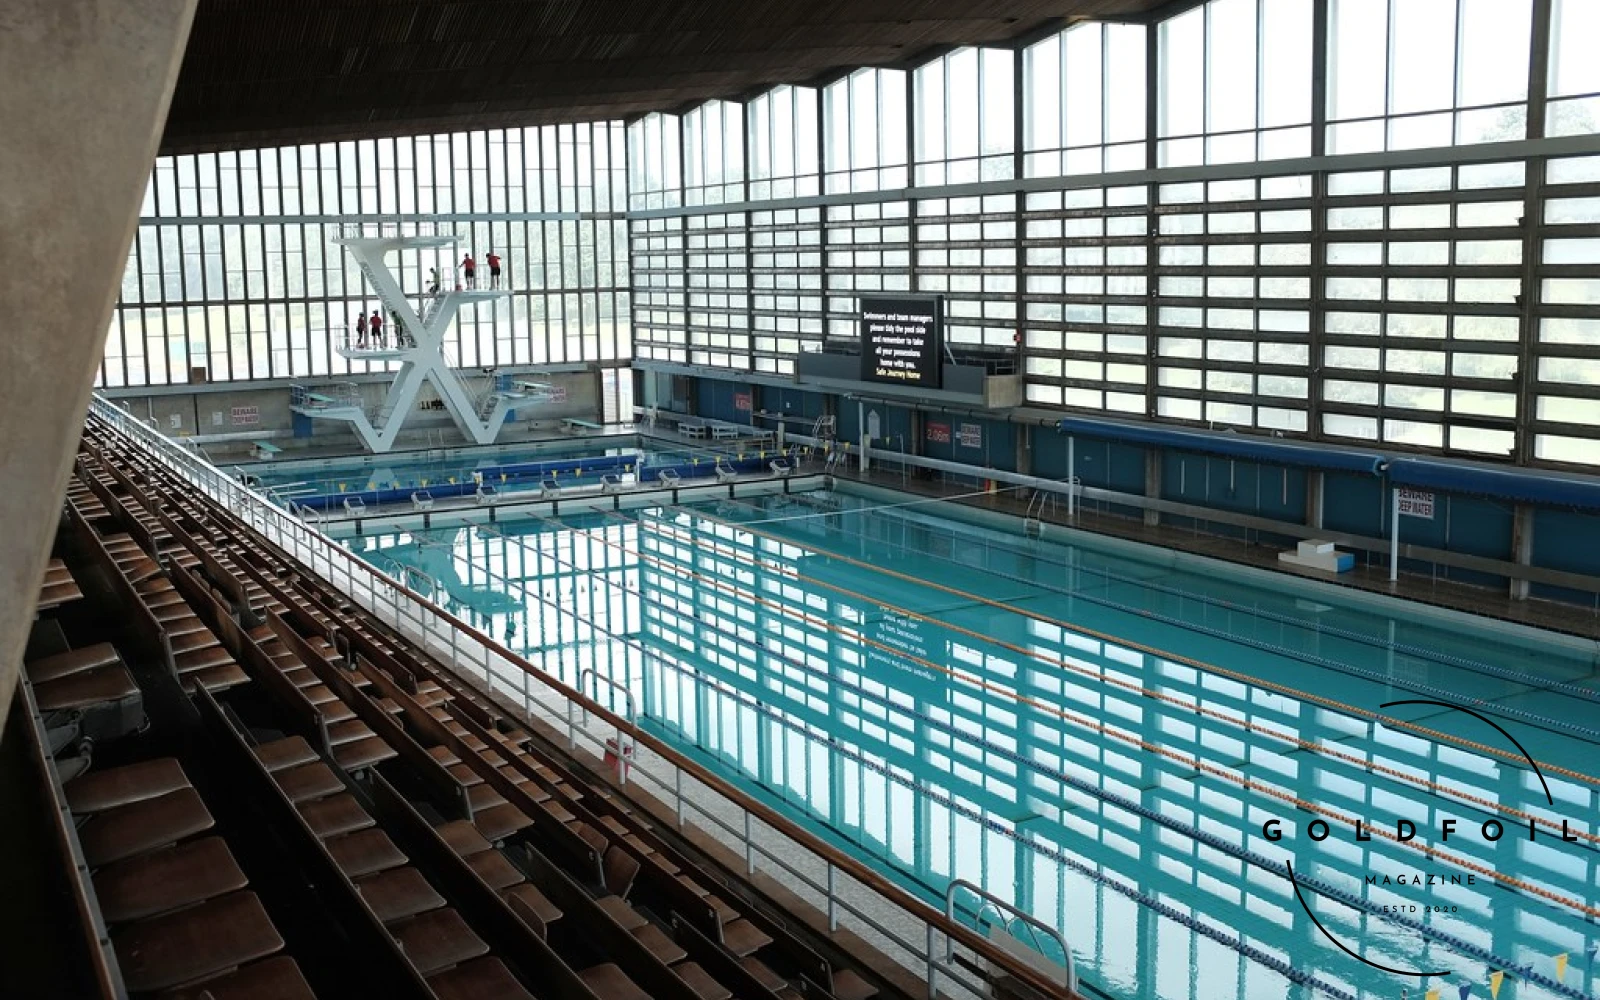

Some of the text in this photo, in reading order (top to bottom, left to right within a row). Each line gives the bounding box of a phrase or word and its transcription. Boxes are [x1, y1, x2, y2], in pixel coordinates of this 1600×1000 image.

[910, 315, 933, 323] managers
[870, 323, 926, 334] please tidy the pool side
[882, 336, 905, 345] remember
[906, 337, 912, 346] to
[912, 338, 924, 346] take
[882, 348, 892, 357] your
[893, 348, 921, 358] possessions
[880, 358, 893, 367] home
[893, 360, 904, 368] with
[876, 367, 921, 379] Safe Journey Home
[1412, 503, 1432, 516] WATER
